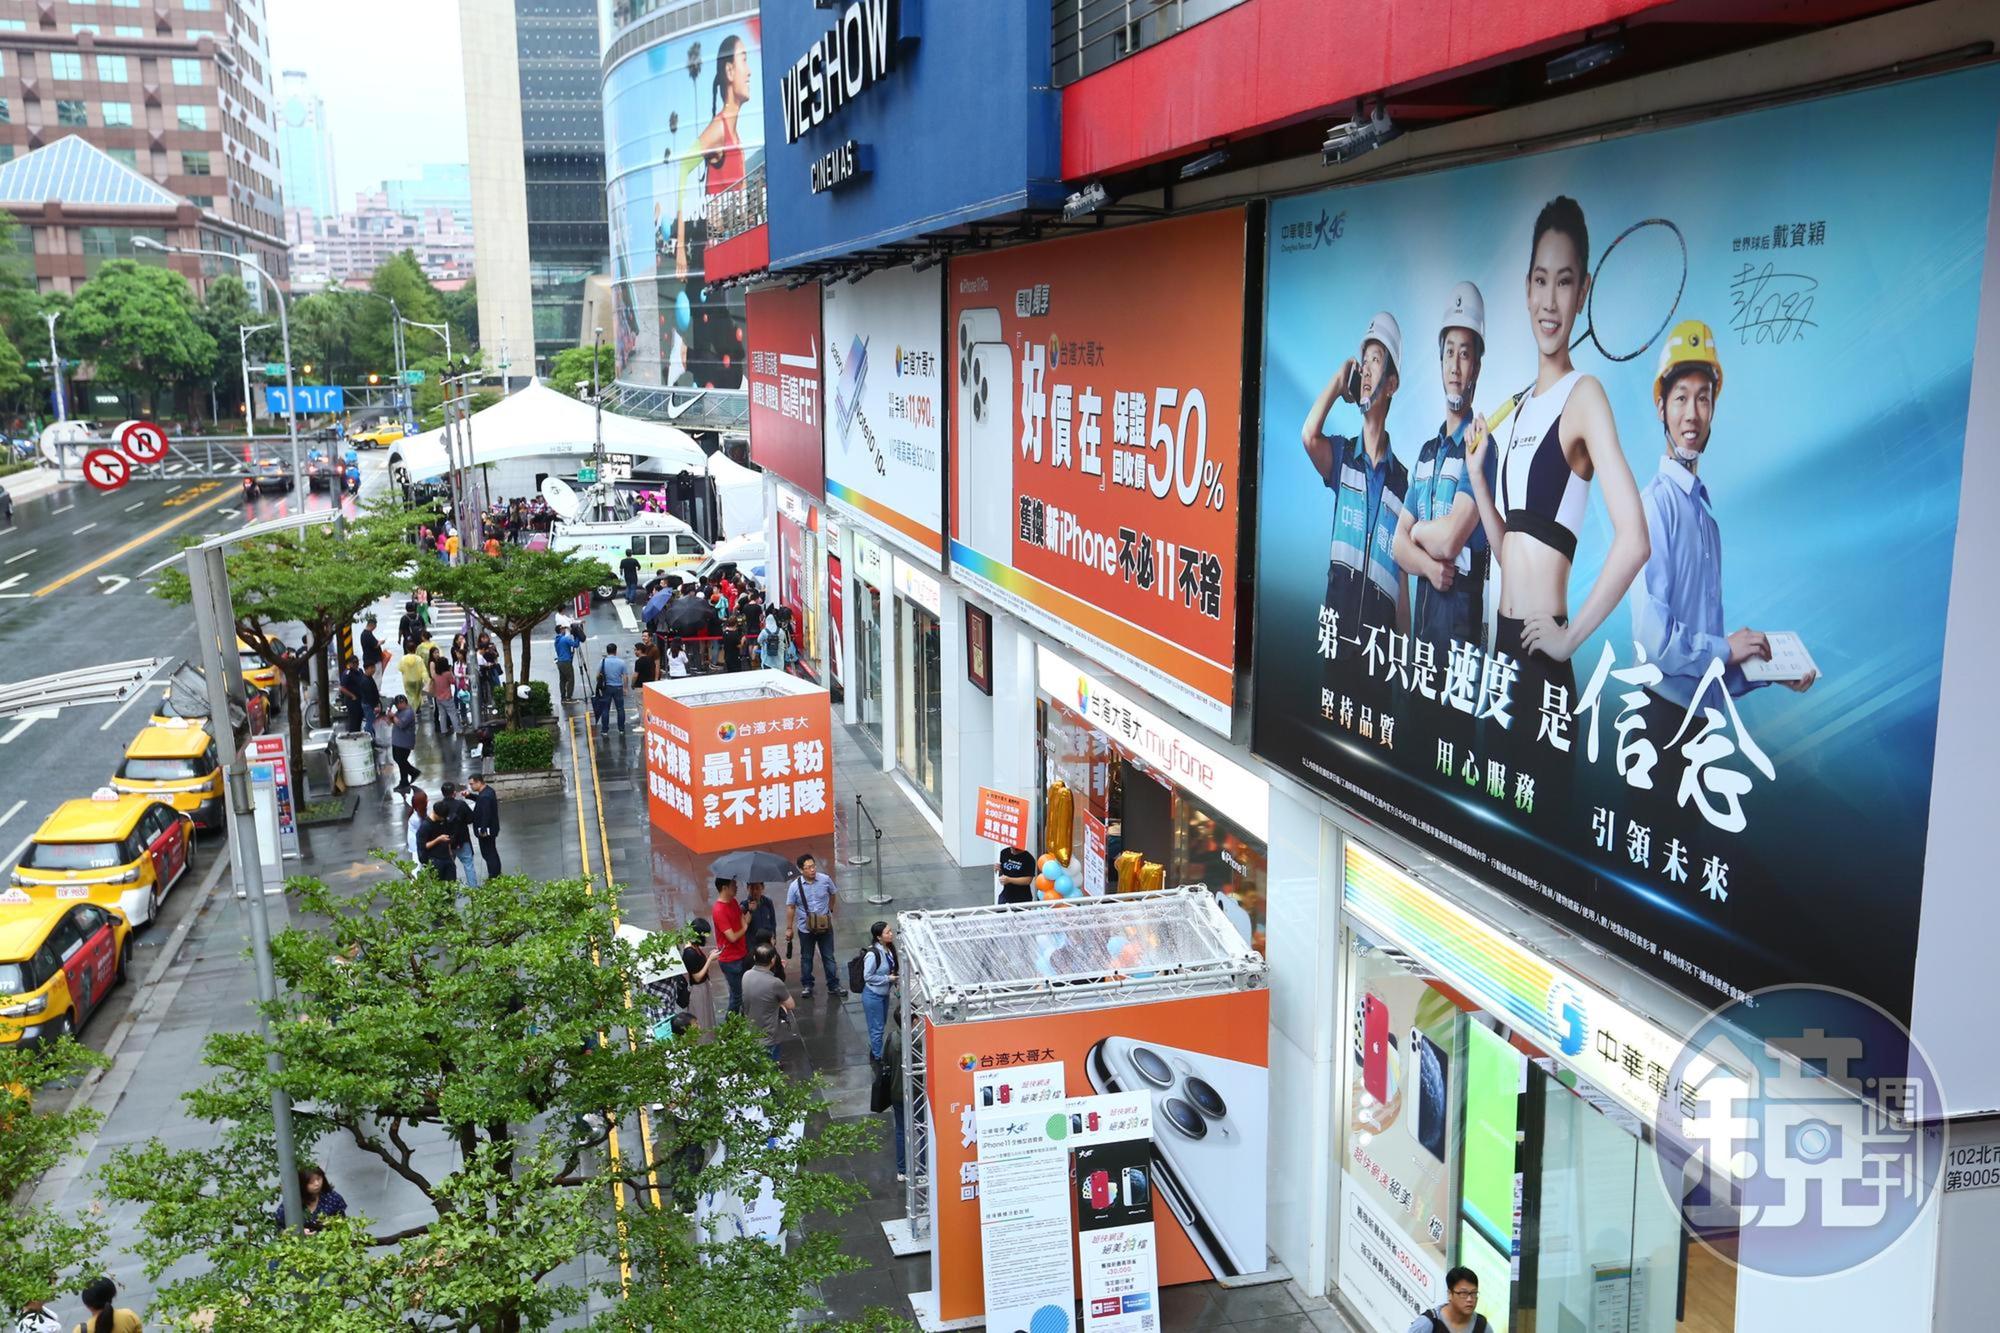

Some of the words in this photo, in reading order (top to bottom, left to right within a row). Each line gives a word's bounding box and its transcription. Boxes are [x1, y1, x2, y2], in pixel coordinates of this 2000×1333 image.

[780, 0, 888, 144] VIESHOW
[811, 140, 853, 195] CINEMAS
[1732, 235, 1771, 252] 世界球后
[1772, 221, 1826, 249] 戴資穎
[1112, 450, 1147, 490] 回收價
[1113, 390, 1147, 447] 保證
[1148, 387, 1225, 511] 50%
[1316, 603, 1520, 731] 第一不只是速度
[702, 739, 825, 788] 最i果粉
[1145, 729, 1214, 790] myfone
[702, 793, 721, 829] 今年
[723, 777, 827, 826] 不排隊
[1320, 686, 1396, 751] 堅持品質
[1435, 736, 1536, 814] 用心服務
[1591, 805, 1730, 903] 引領未來
